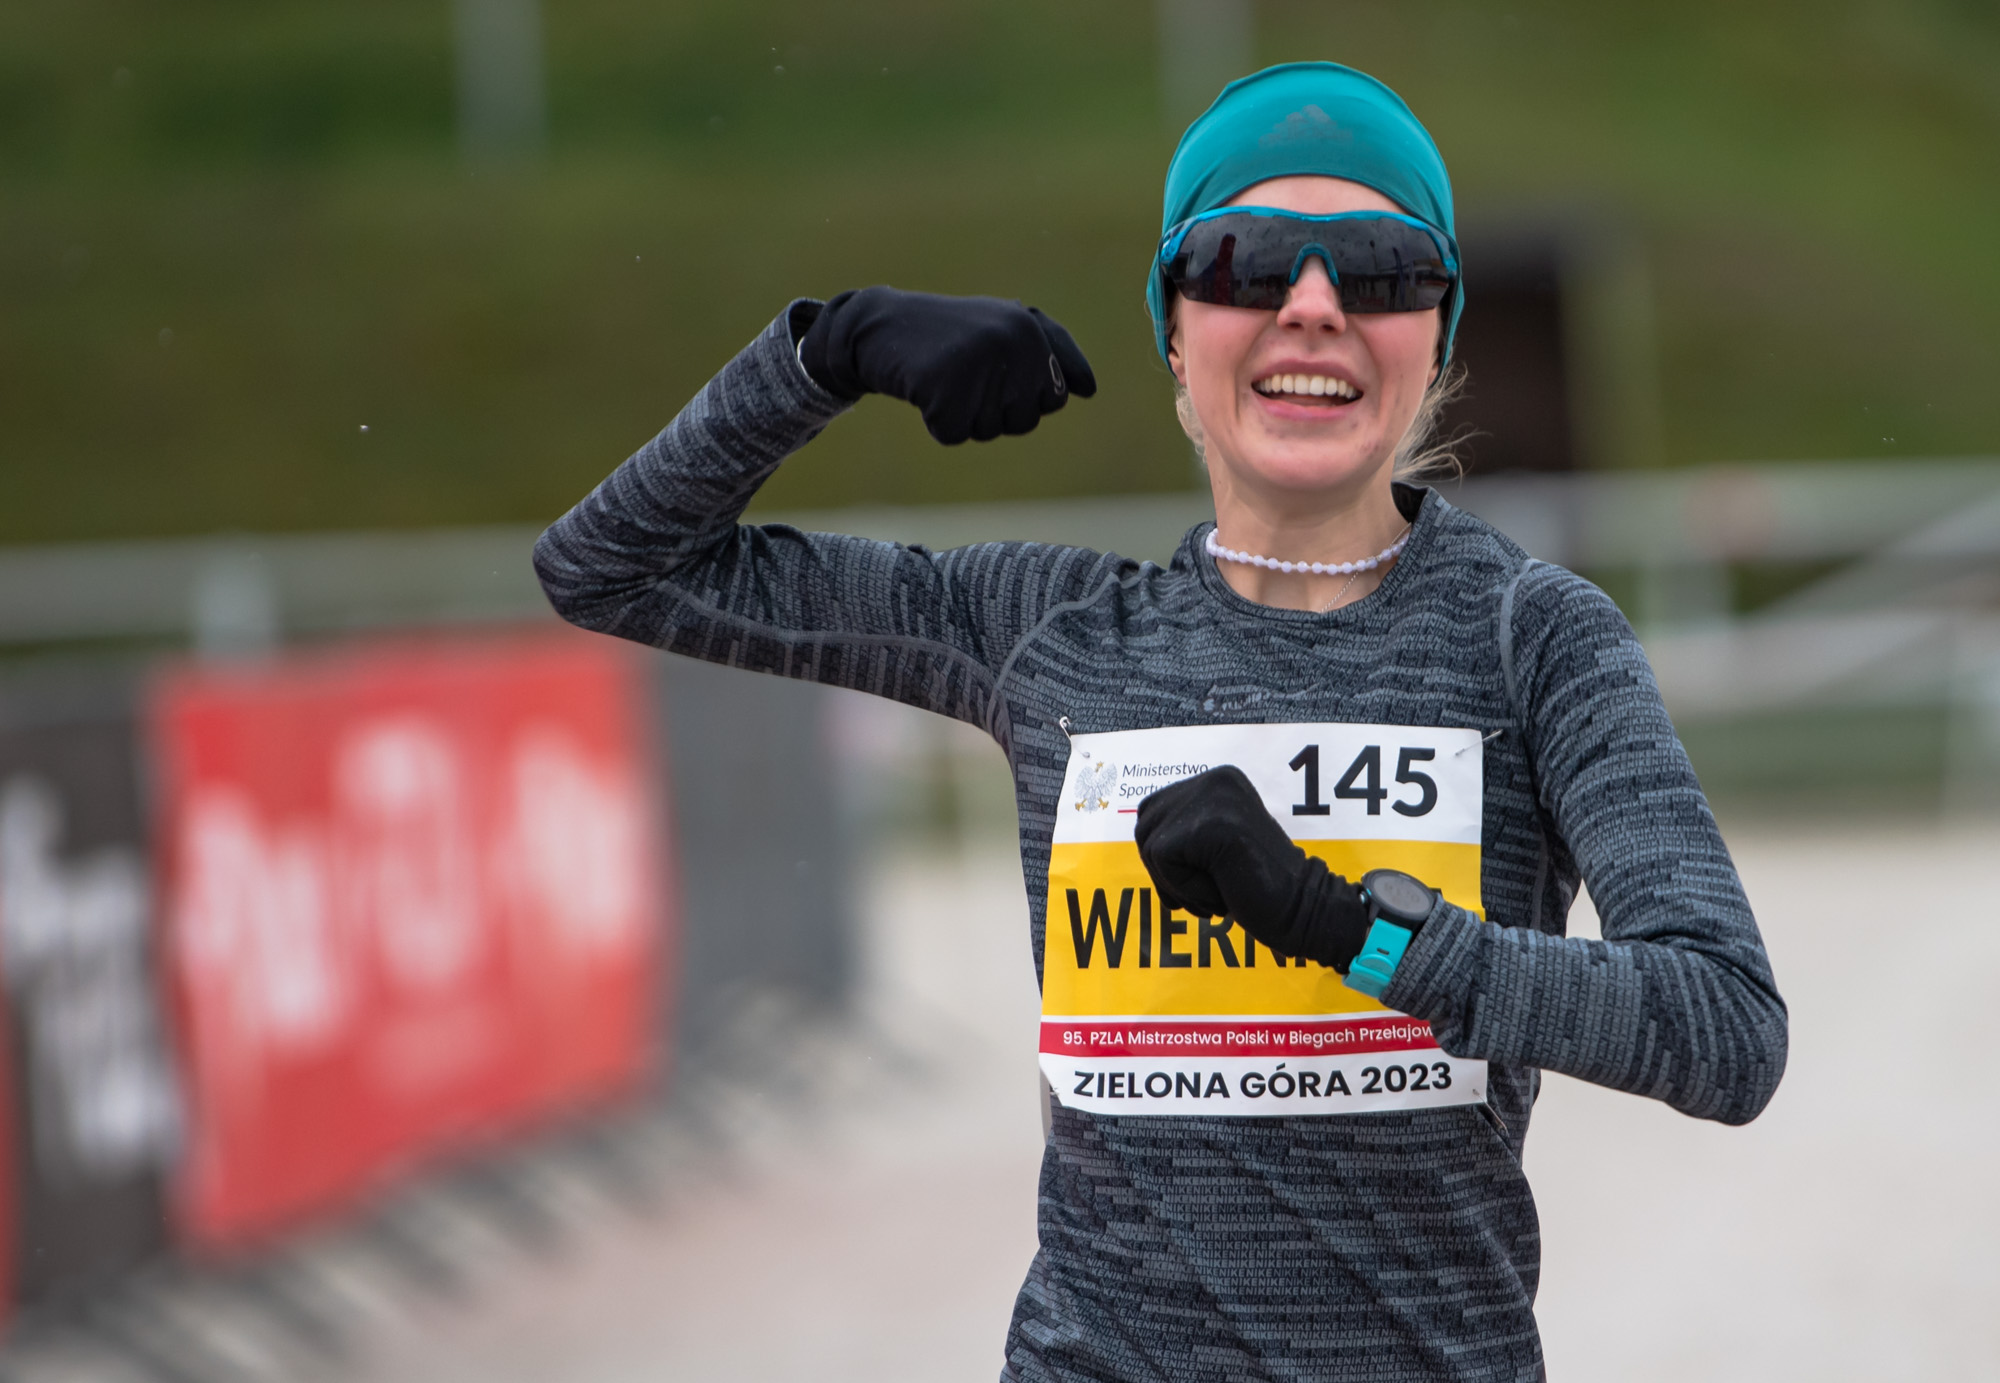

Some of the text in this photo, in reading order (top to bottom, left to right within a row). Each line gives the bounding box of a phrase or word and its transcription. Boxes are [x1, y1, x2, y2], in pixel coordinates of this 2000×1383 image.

[1122, 762, 1209, 778] Ministerstwo
[1288, 744, 1438, 817] 145
[1063, 1031, 1087, 1045] 95.
[1090, 1031, 1124, 1045] PZLA
[1128, 1030, 1222, 1045] Mistrzostwa
[1226, 1030, 1269, 1045] Polski
[1272, 1033, 1286, 1044] w
[1289, 1028, 1355, 1048] Biegach
[1073, 1061, 1452, 1099] ZIELONA GÓRA 2023
